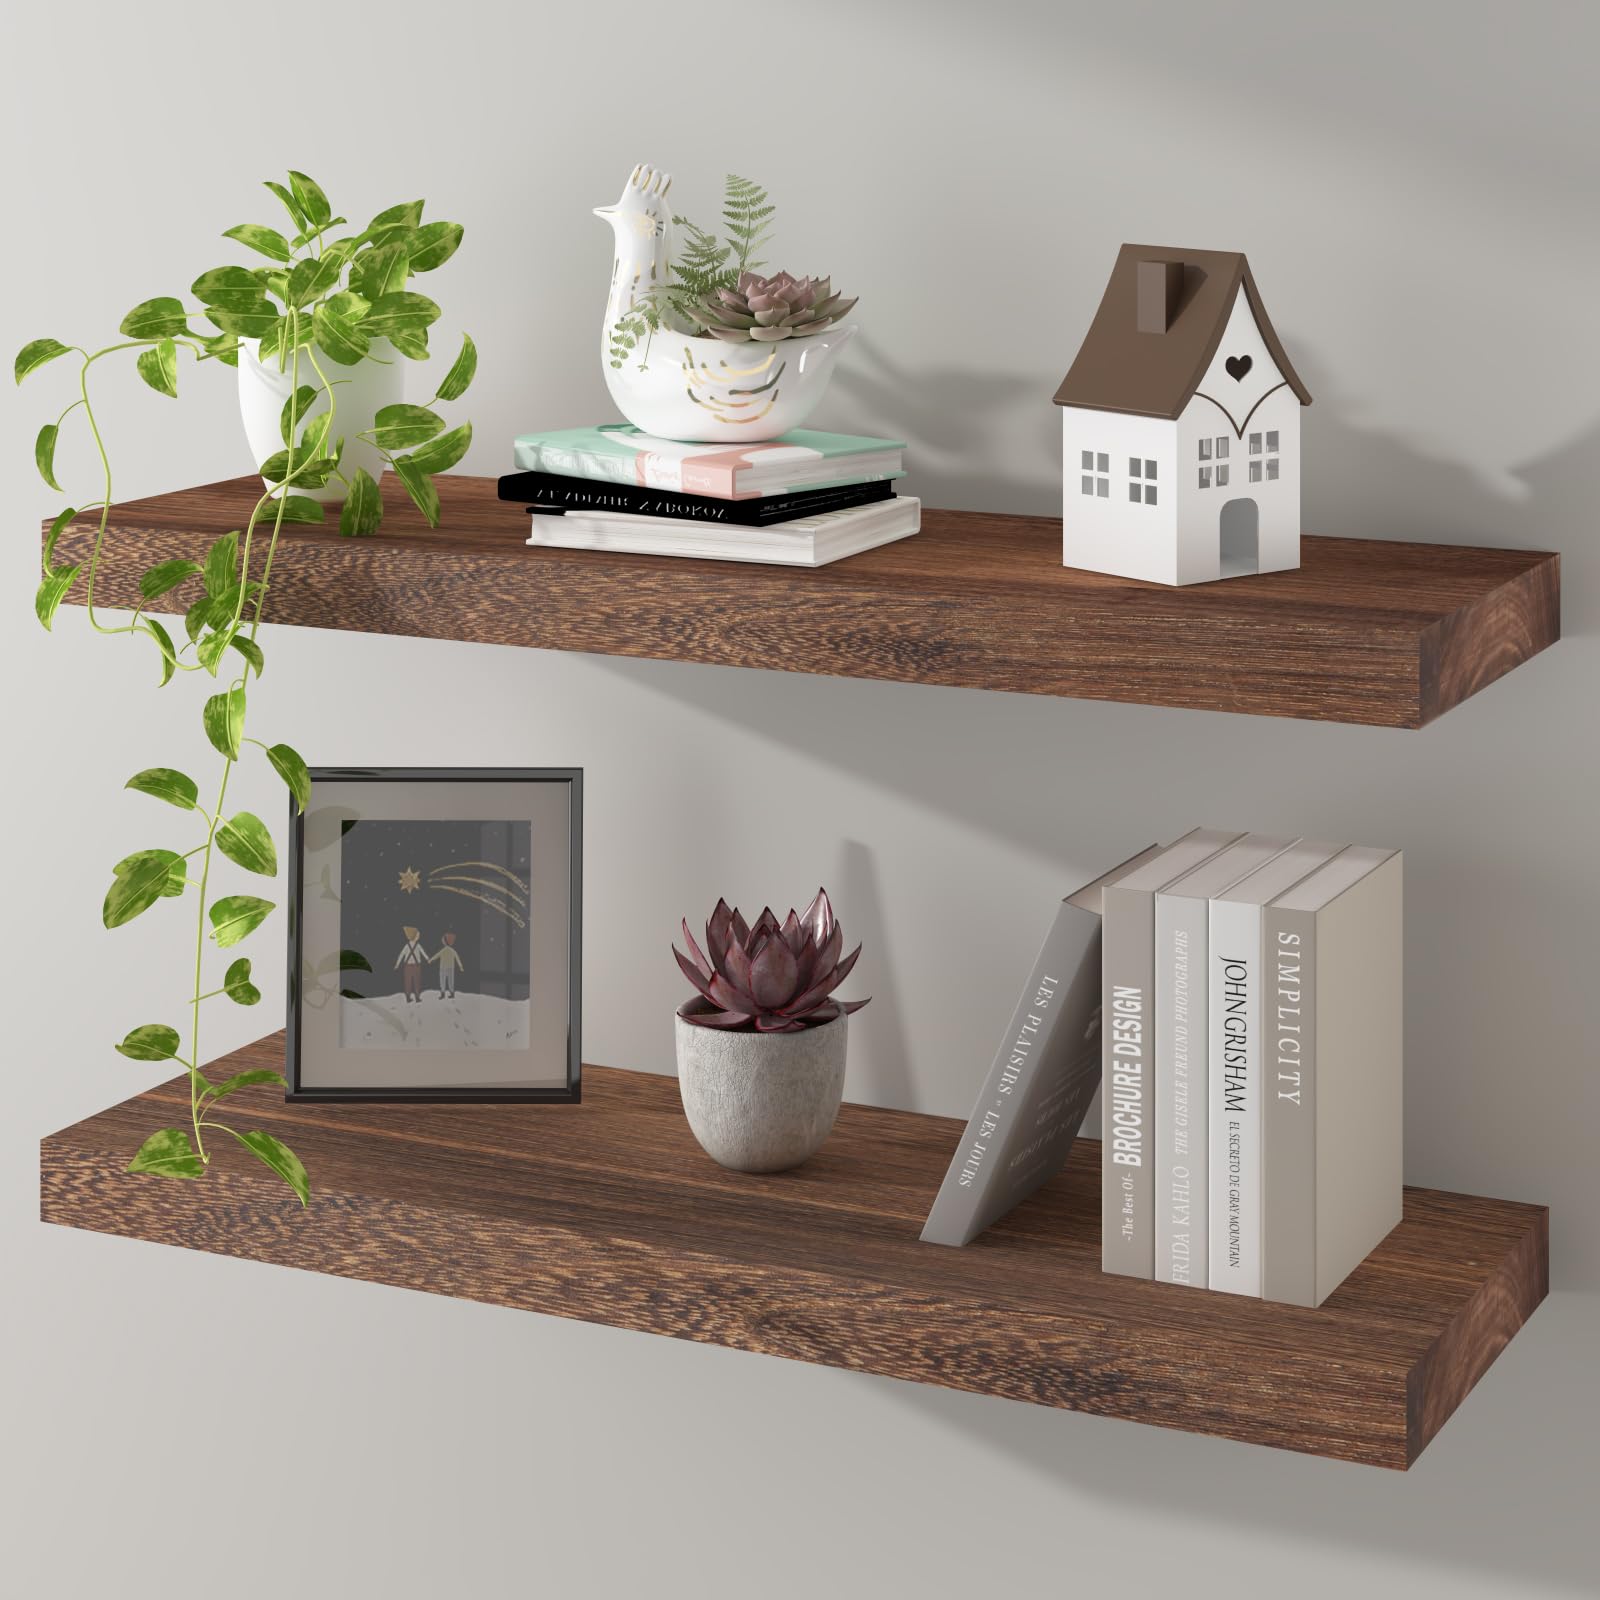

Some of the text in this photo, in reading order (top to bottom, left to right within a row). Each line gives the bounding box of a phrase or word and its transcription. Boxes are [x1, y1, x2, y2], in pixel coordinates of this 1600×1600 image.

[958, 975, 1059, 1188] LES PLAISIRS LES JOURS
[1112, 985, 1143, 1167] BROCHURE DESIGN
[1175, 930, 1189, 1155] THE GISELE FREUND PHOTOGRAPHS
[1277, 931, 1301, 1106] SIMPLICITY
[1121, 1193, 1134, 1214] Best
[1172, 1166, 1191, 1284] FRIDA KAHLO
[1229, 1121, 1241, 1269] EL SECRETO DE GRAY MOUNTAIN
